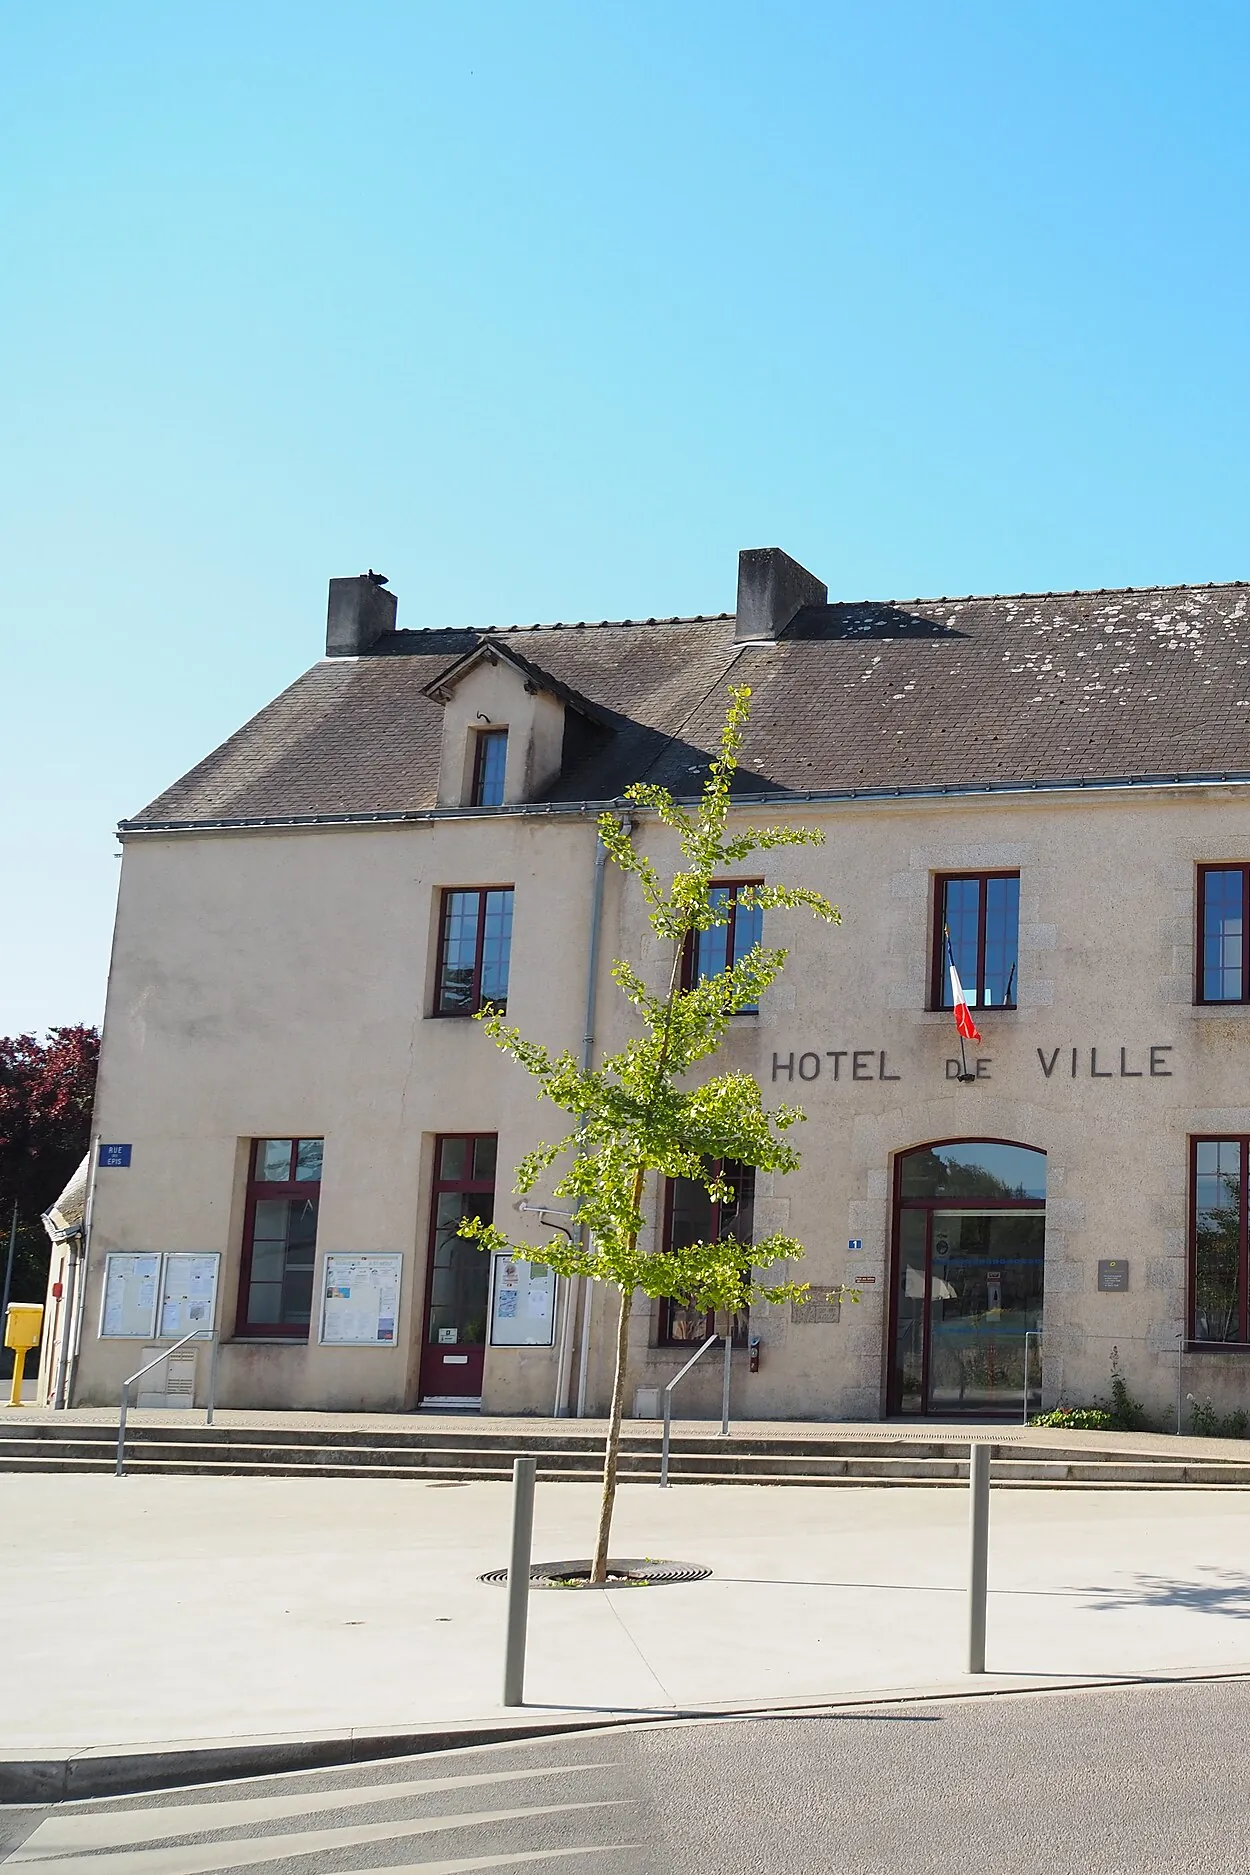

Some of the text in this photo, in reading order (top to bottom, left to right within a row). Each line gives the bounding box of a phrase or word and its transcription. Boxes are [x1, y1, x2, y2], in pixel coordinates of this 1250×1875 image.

[771, 1045, 1173, 1082] HOTEL DE VILLE
[108, 1146, 123, 1154] RUE
[853, 1240, 858, 1249] 1
